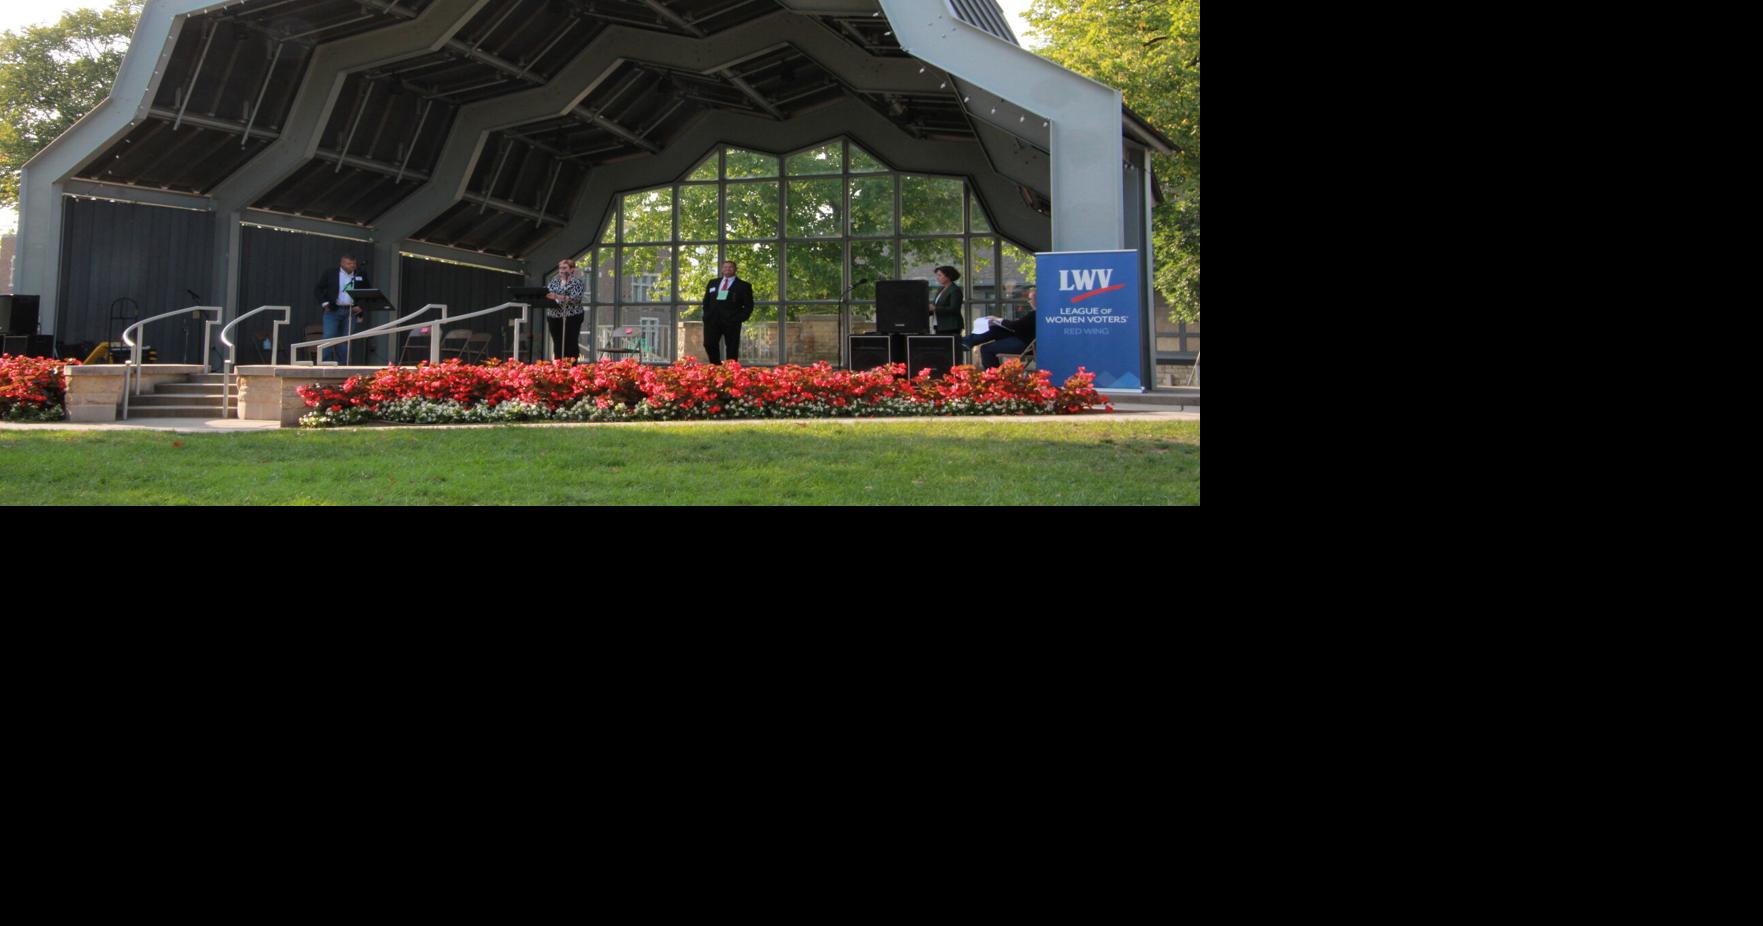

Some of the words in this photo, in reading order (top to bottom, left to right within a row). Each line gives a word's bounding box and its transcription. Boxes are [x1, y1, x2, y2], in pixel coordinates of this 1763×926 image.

[1058, 268, 1113, 291] LWV
[1060, 307, 1099, 315] LEAGUE
[1084, 327, 1109, 335] WING
